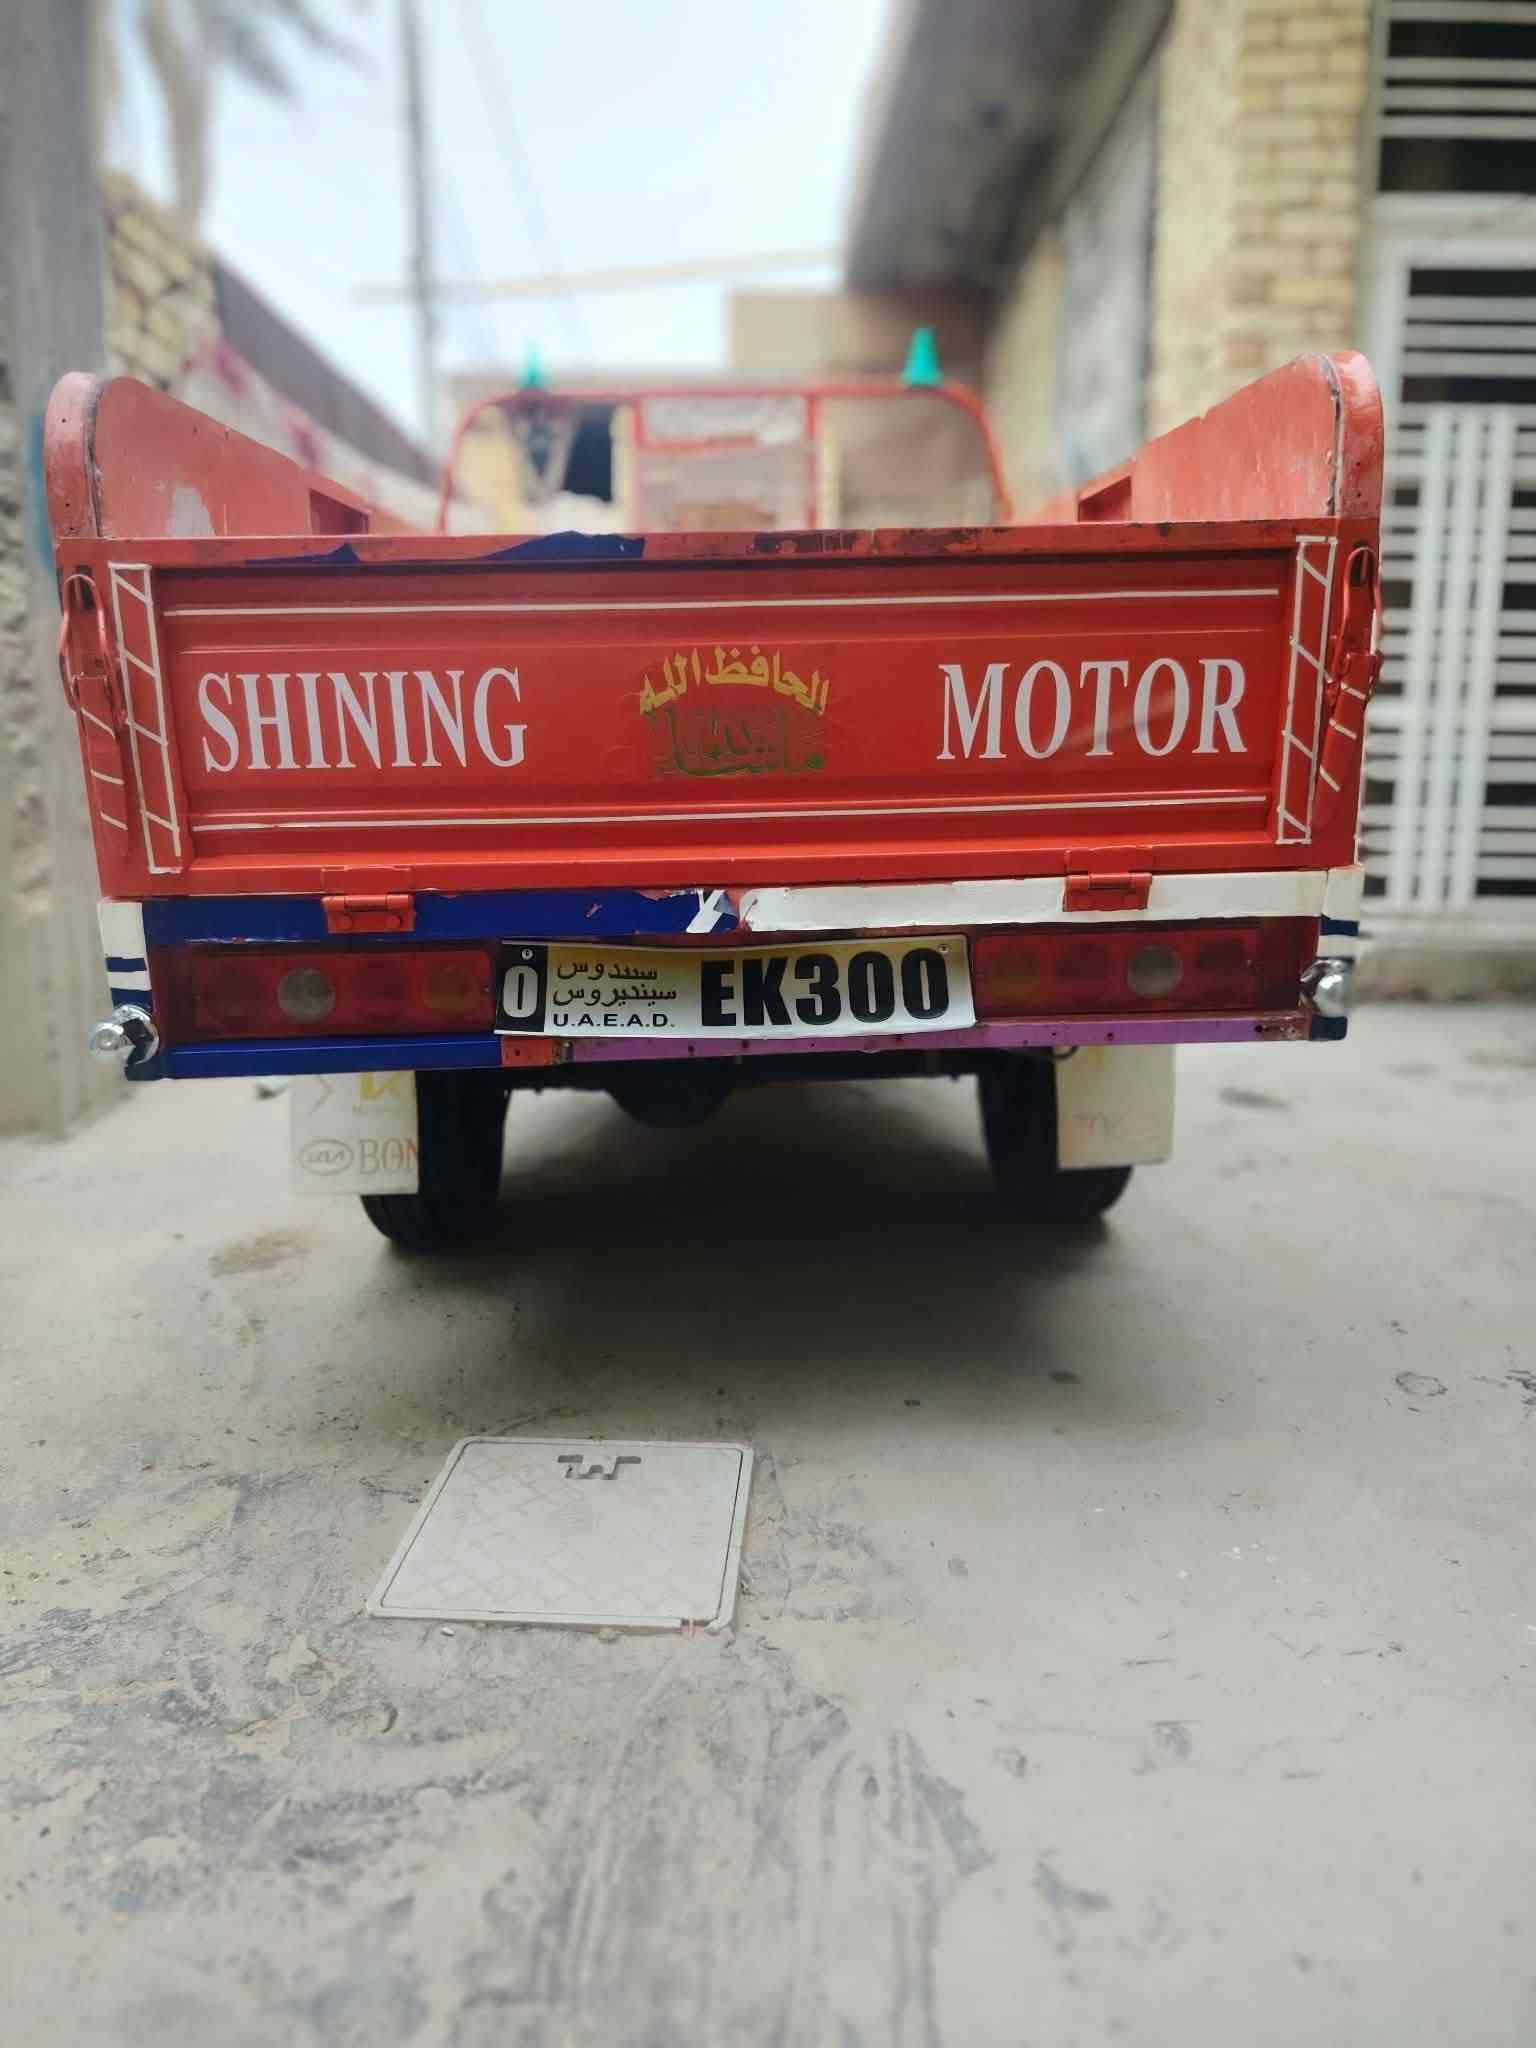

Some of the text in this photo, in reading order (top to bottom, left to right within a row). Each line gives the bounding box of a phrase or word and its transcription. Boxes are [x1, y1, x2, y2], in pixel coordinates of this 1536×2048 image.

[198, 667, 527, 773] SHINING
[936, 657, 1248, 760] MOTOR
[701, 948, 949, 1028] EK300
